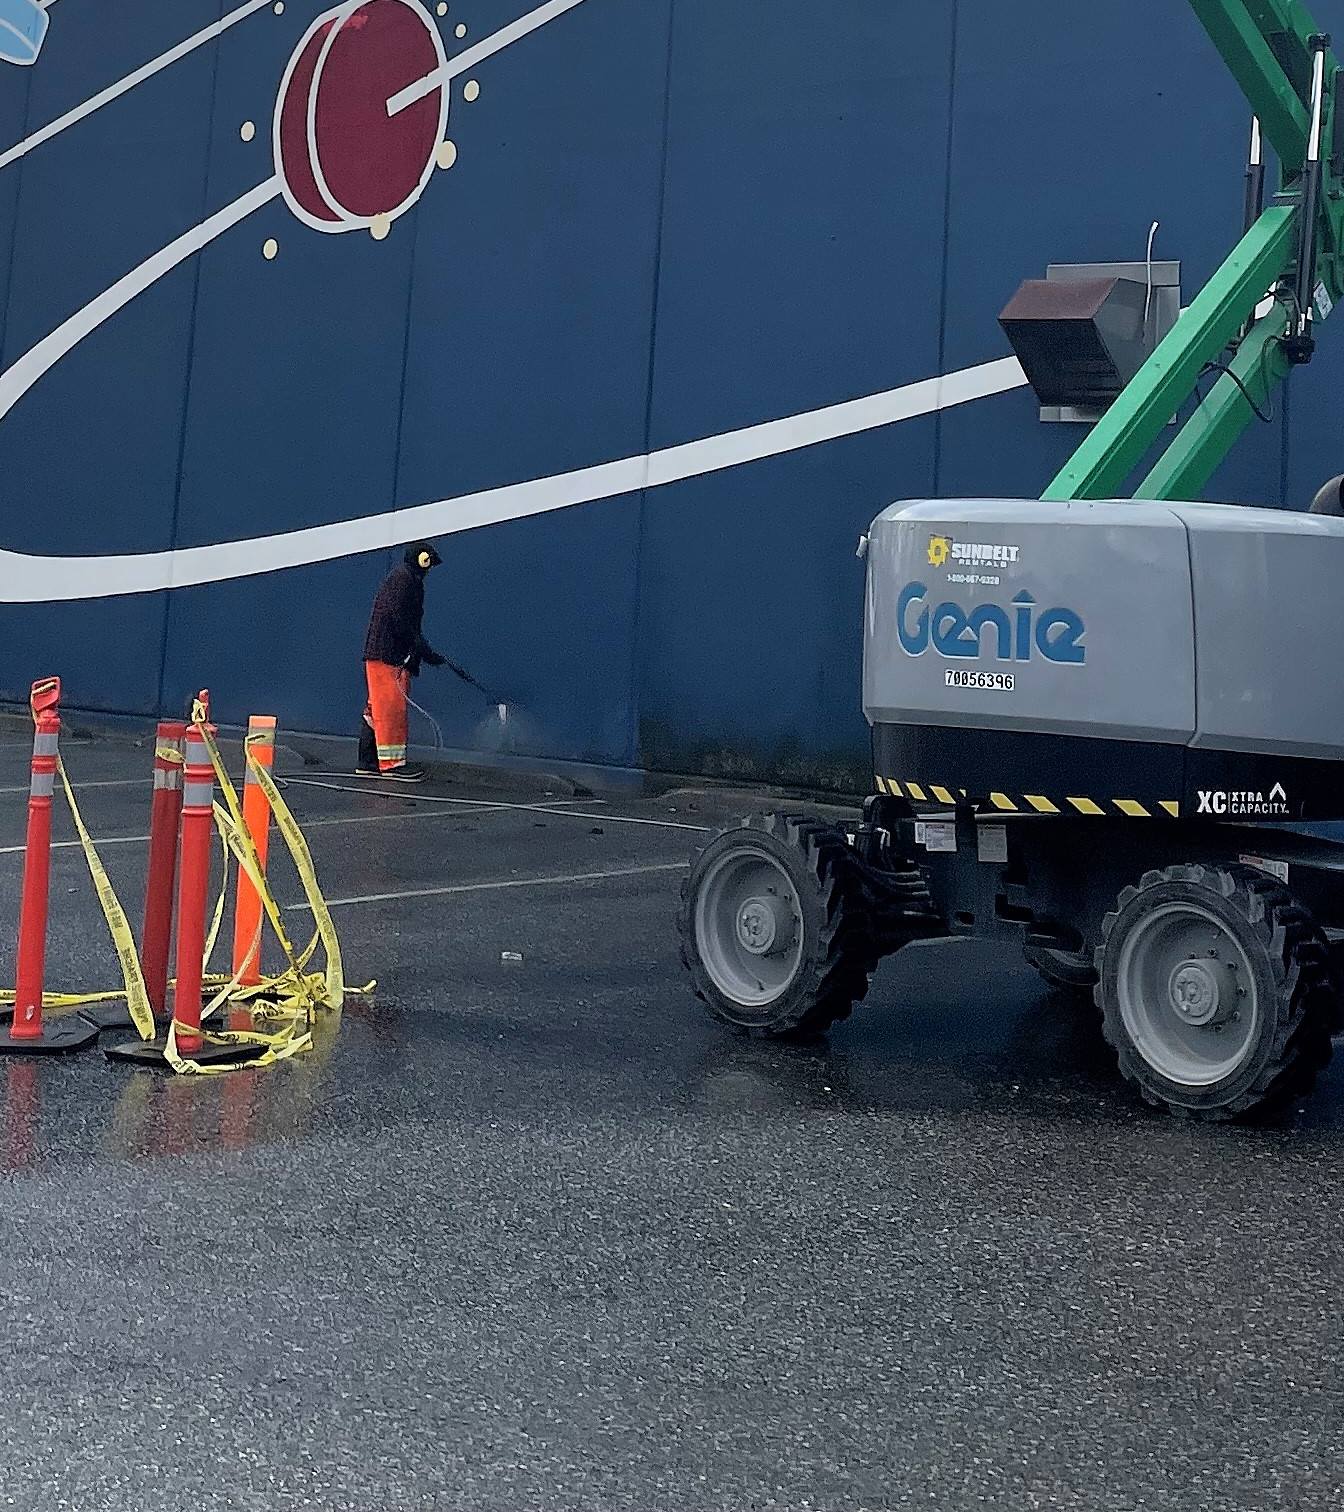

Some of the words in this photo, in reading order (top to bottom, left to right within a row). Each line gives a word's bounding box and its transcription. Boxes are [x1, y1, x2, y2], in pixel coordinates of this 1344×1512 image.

[951, 542, 1020, 562] SUNBELT
[958, 558, 1007, 568] RENTALS
[895, 580, 1086, 666] Genie
[946, 669, 1014, 690] 70056396
[1196, 790, 1227, 814] XC
[1231, 791, 1263, 802] XTRA
[1231, 802, 1287, 815] CAPACITY
